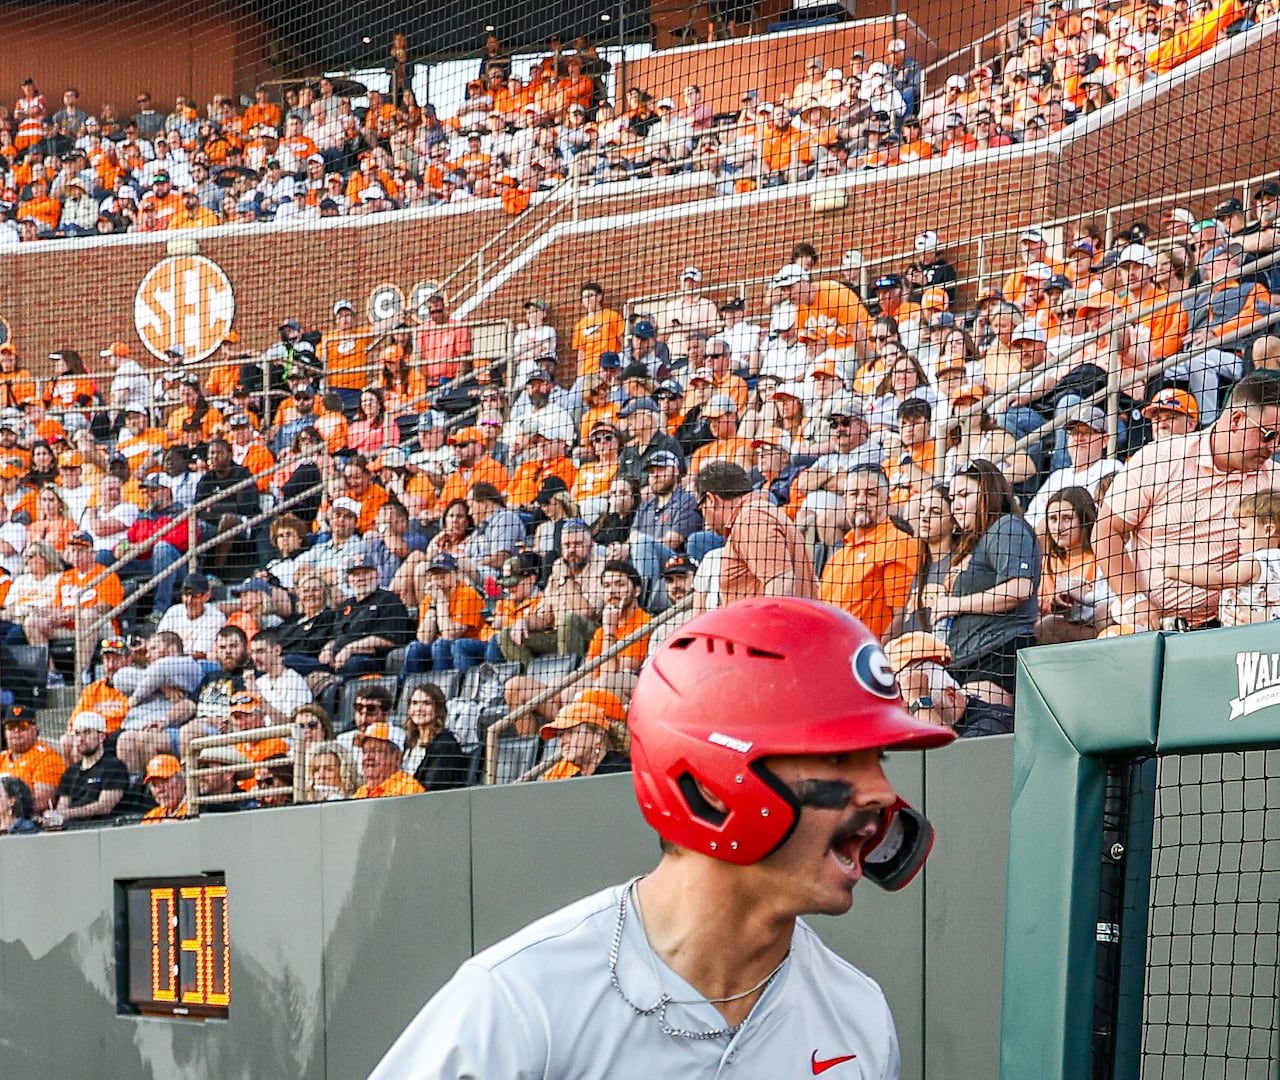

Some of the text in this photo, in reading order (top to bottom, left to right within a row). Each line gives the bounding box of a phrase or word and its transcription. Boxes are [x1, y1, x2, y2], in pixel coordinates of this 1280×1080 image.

[136, 255, 234, 362] SEC
[375, 293, 395, 317] C
[852, 643, 900, 699] G
